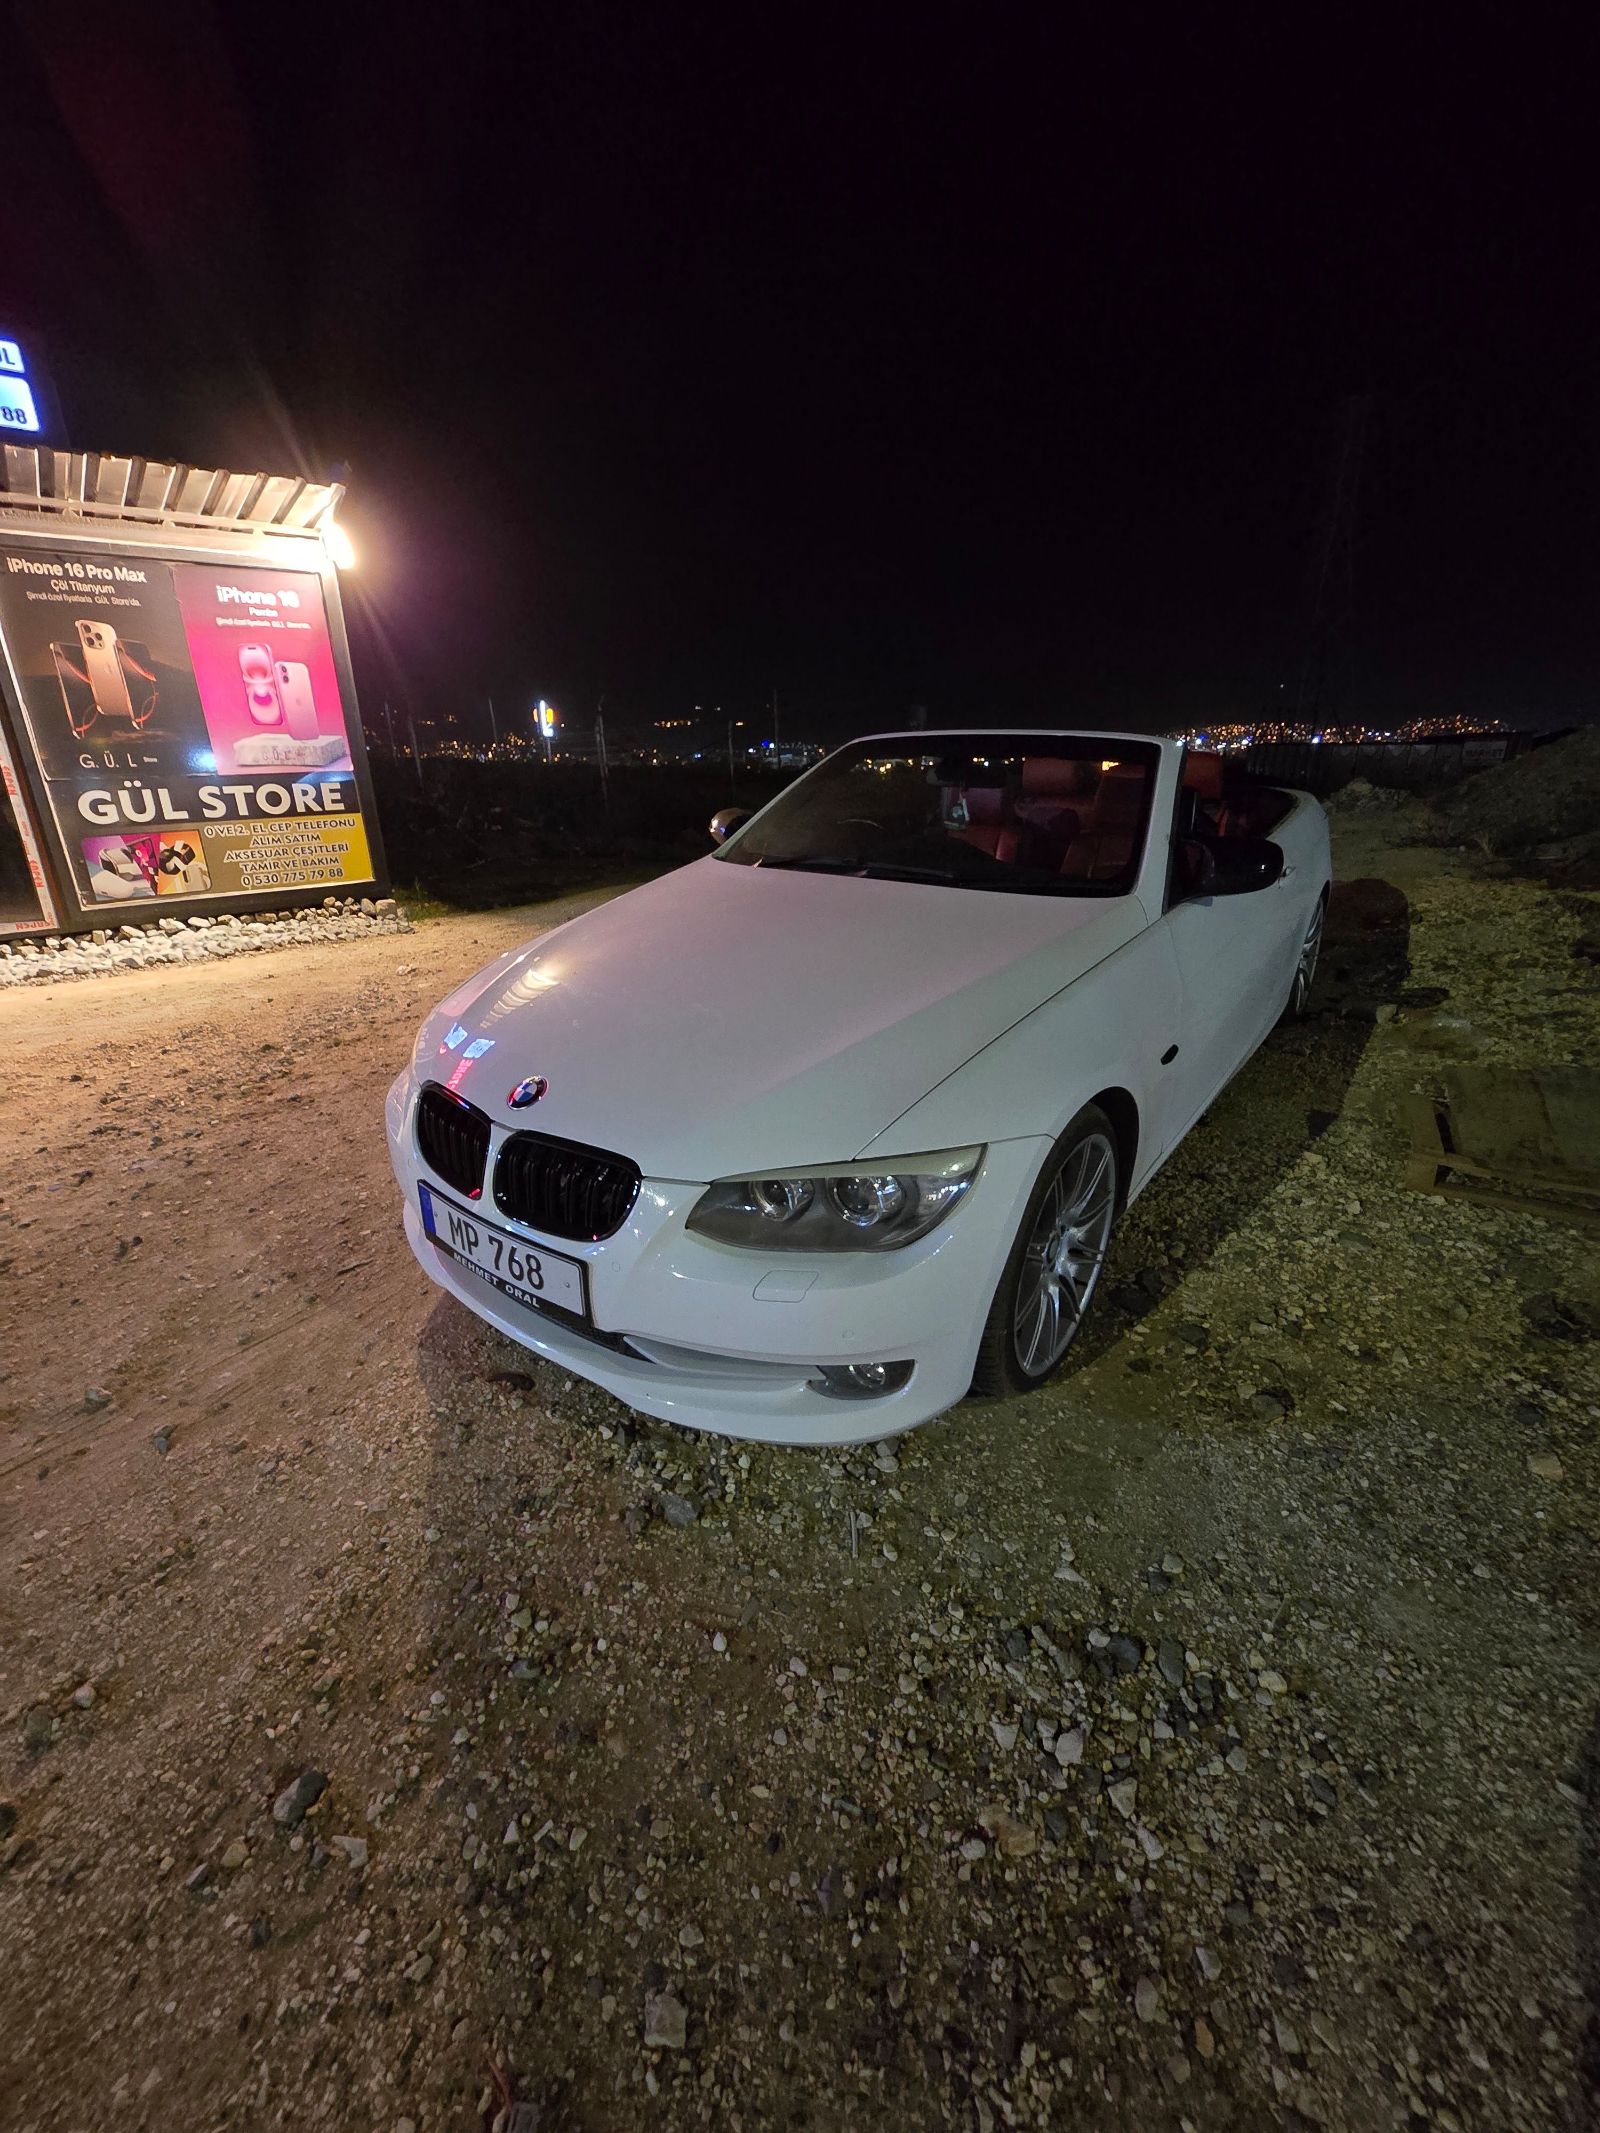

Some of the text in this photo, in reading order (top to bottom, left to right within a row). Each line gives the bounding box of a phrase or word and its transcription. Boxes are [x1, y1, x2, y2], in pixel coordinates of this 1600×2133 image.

[6, 557, 147, 583] iPhone 16 Pro Max
[51, 579, 115, 595] Çöl Titanyum
[216, 584, 276, 606] iPhone
[77, 780, 345, 825] GÜL STORE
[215, 825, 233, 836] VE
[237, 824, 249, 834] 2.
[252, 824, 266, 834] EL
[269, 823, 292, 833] CEP
[295, 818, 356, 831] TELEFONU
[251, 834, 321, 846] ALIM SATIM
[225, 842, 349, 862] AKSESUAR ÇEŞİTLERİ
[241, 856, 340, 873] TAMİR VE BAKIM
[242, 867, 344, 886] 0 530 775 79 88
[447, 1211, 545, 1291] MP 768
[453, 1251, 541, 1309] MEHMET ORAL
